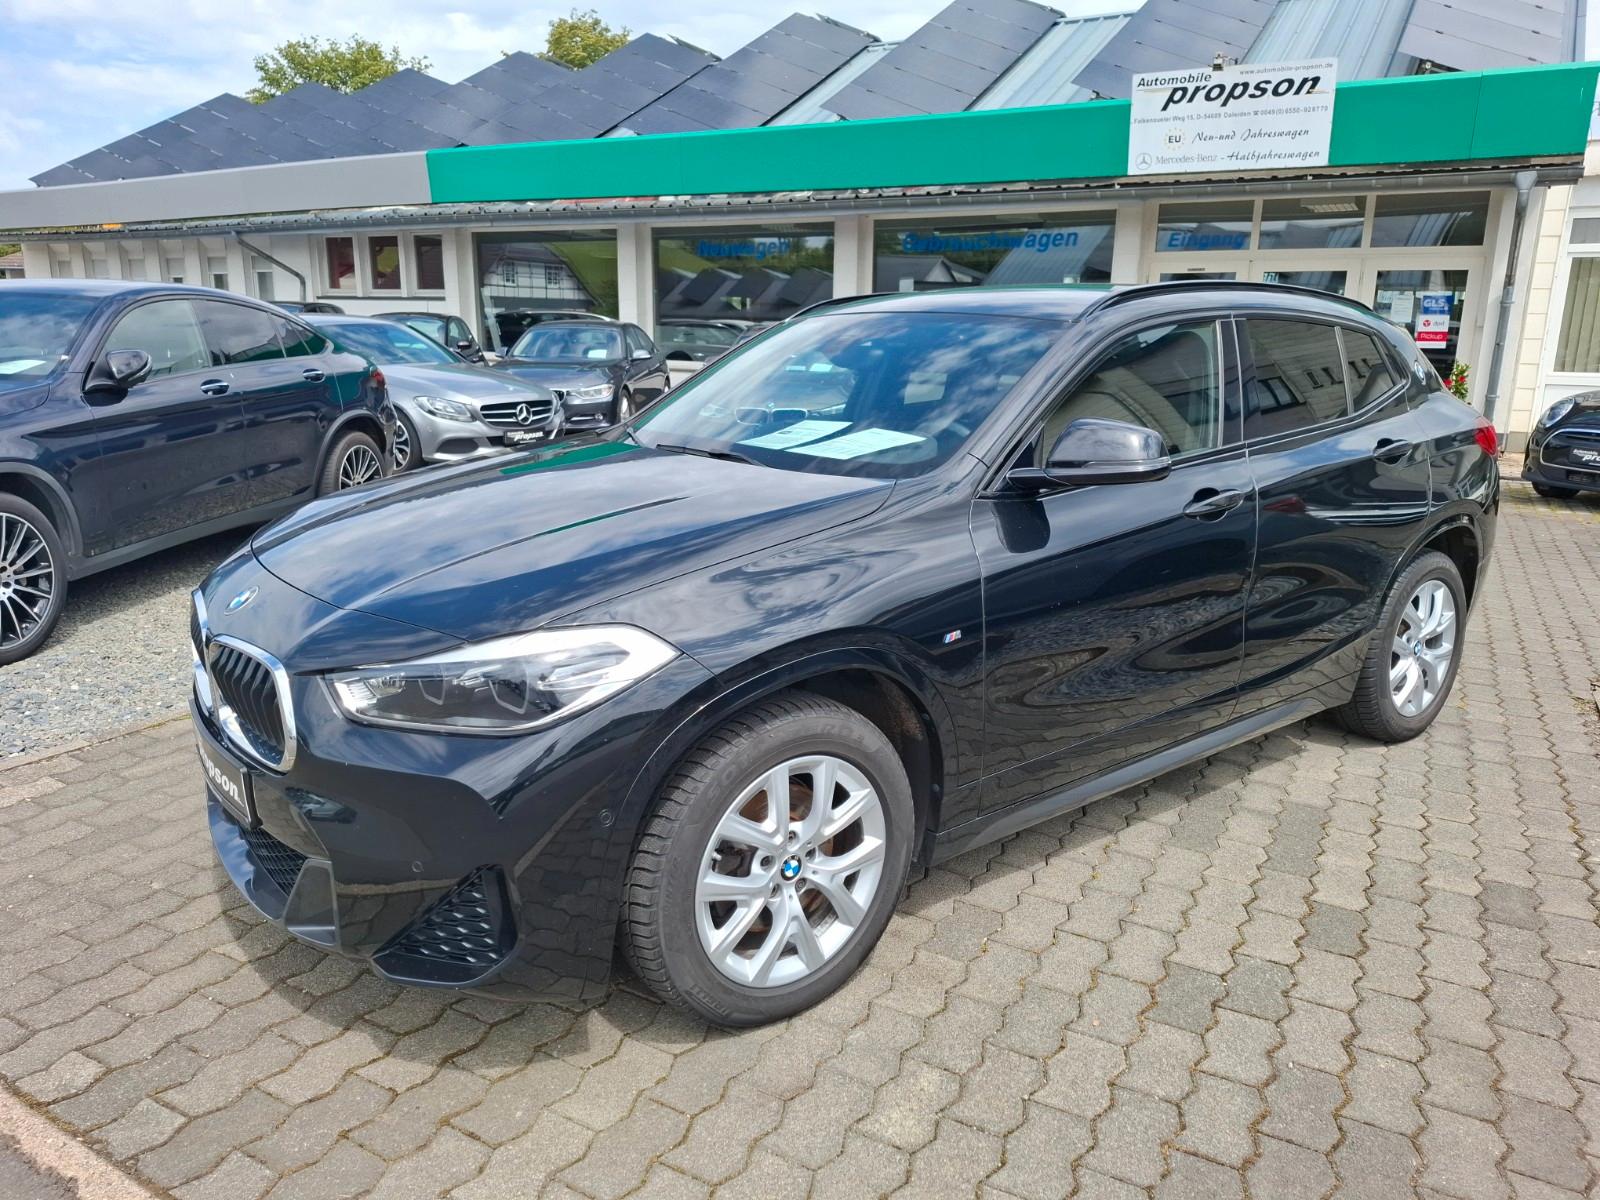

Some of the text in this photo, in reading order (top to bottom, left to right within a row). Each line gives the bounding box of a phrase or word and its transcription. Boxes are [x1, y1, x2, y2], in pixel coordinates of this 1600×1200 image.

[1137, 72, 1212, 88] Automobile
[1161, 75, 1321, 112] propson
[1168, 135, 1182, 144] EU
[1240, 128, 1309, 141] Jahreswagen
[1168, 231, 1245, 250] Eingang
[1423, 298, 1445, 308] GLS
[1420, 332, 1444, 340] Pickup
